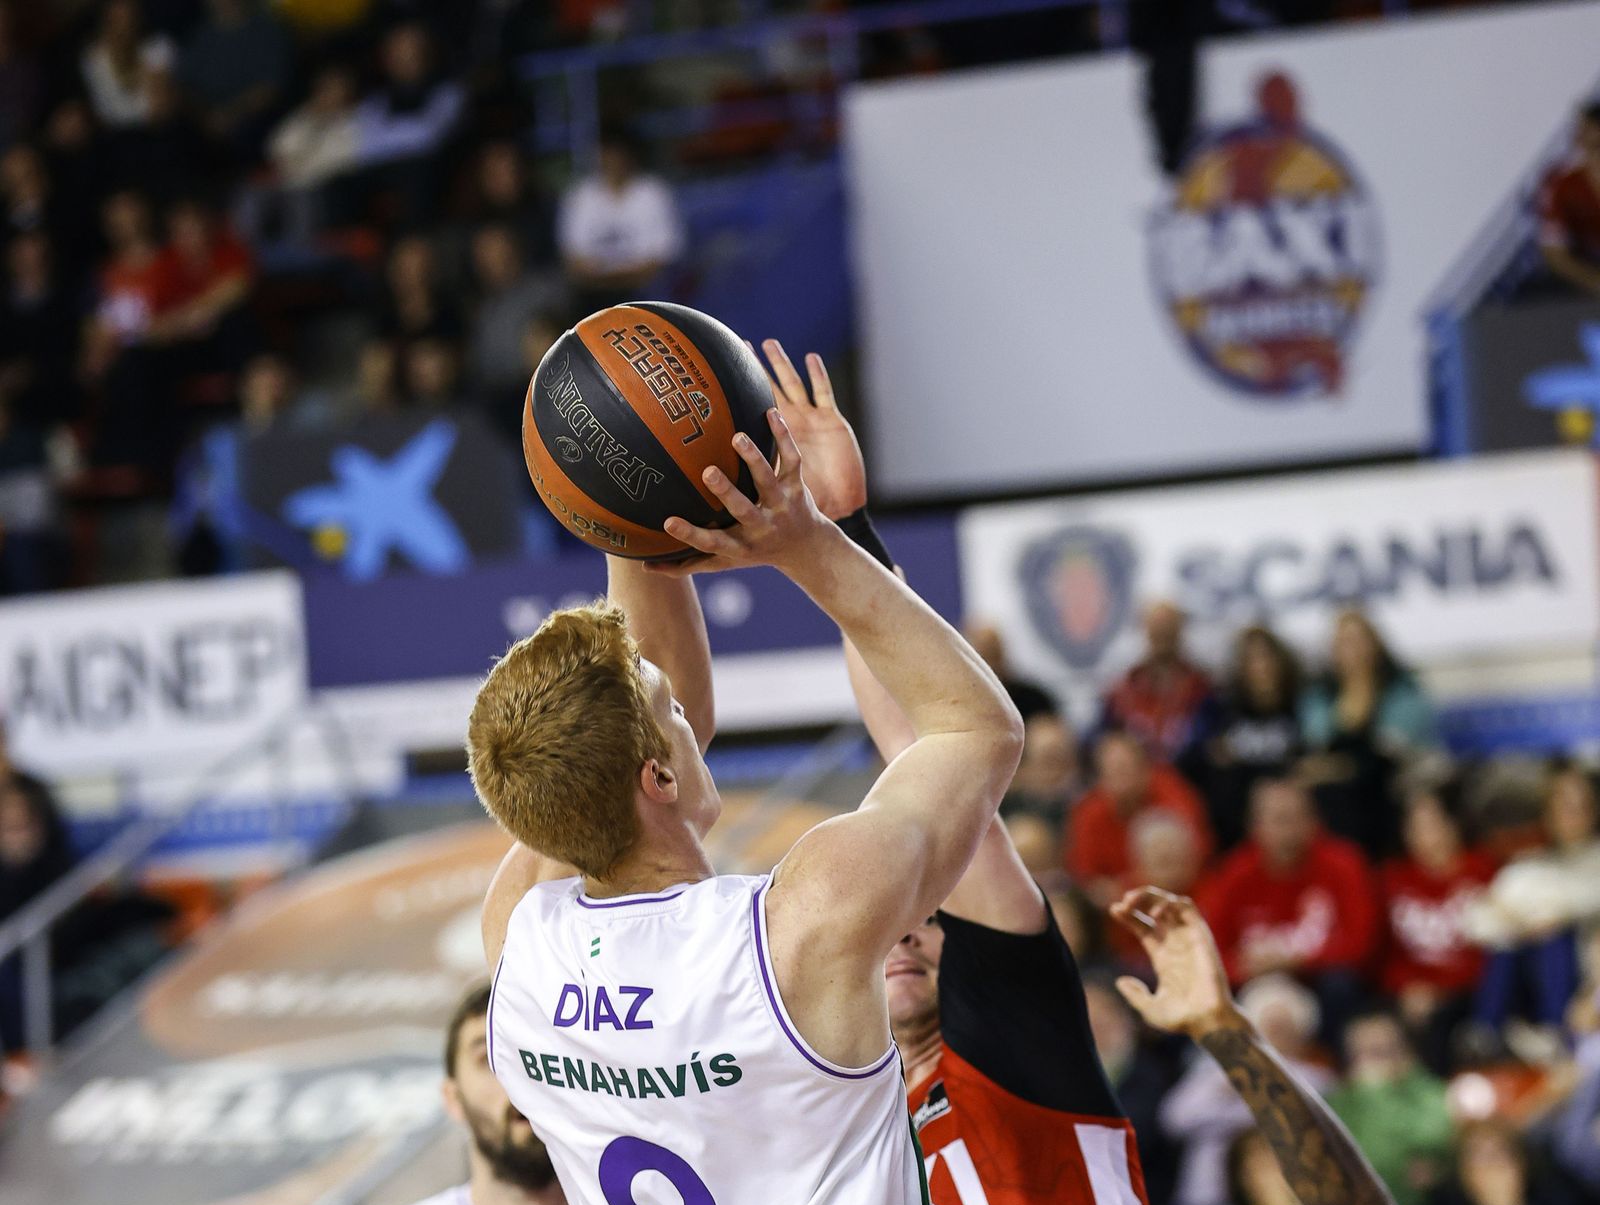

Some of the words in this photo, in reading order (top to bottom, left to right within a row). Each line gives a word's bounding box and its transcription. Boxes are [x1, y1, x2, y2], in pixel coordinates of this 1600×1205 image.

[601, 327, 705, 447] LEGACY
[633, 323, 696, 390] 1000
[542, 353, 664, 501] SPALDING
[518, 1048, 743, 1100] BENAHAVÍS
